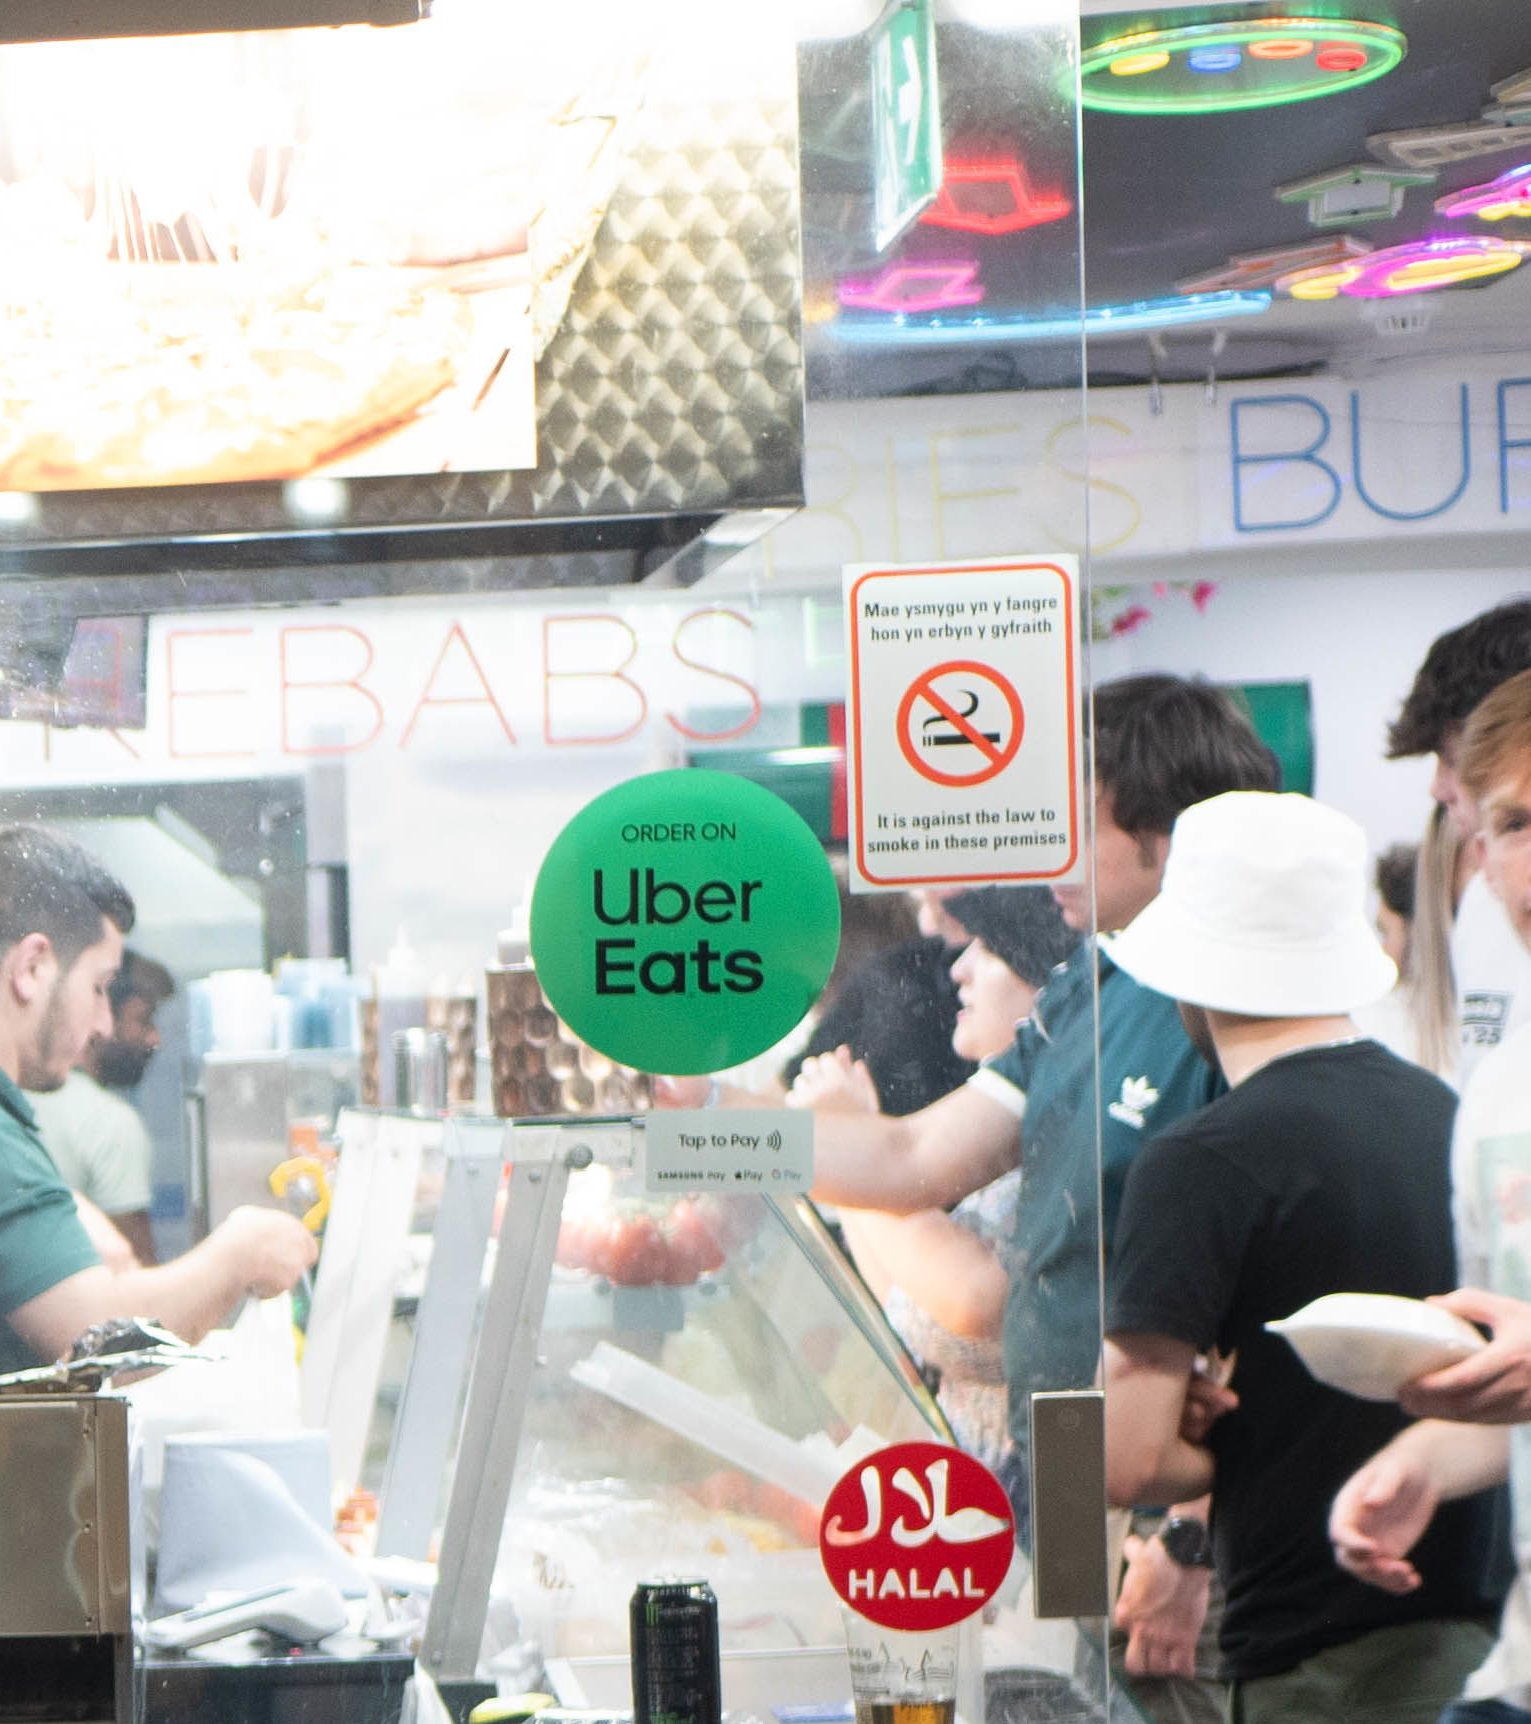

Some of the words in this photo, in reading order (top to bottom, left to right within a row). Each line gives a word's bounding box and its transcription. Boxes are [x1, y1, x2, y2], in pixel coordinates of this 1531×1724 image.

[864, 603, 899, 618] Mae
[905, 603, 964, 621] ysmygu
[970, 602, 987, 617] yn
[993, 601, 1001, 614] y
[1007, 596, 1057, 613] fangre
[871, 627, 899, 641] hon
[905, 628, 922, 642] yn
[929, 624, 972, 641] erbyn
[978, 626, 986, 639] y
[991, 619, 1052, 639] gyfraith
[878, 814, 889, 828] It
[893, 813, 906, 828] is
[911, 811, 970, 830] against
[976, 810, 1000, 825] the
[1006, 809, 1035, 823] law
[1041, 809, 1055, 822] to
[621, 823, 695, 842] ORDER
[701, 822, 737, 841] ON
[868, 837, 919, 853] smoke
[925, 836, 939, 850] in
[945, 834, 988, 850] these
[993, 832, 1066, 852] premises
[593, 867, 762, 926] Uber
[595, 939, 764, 995] Eats
[678, 1134, 705, 1151] Tap
[711, 1134, 727, 1147] to
[731, 1133, 761, 1150] Pay
[848, 1566, 985, 1600] HALAL
